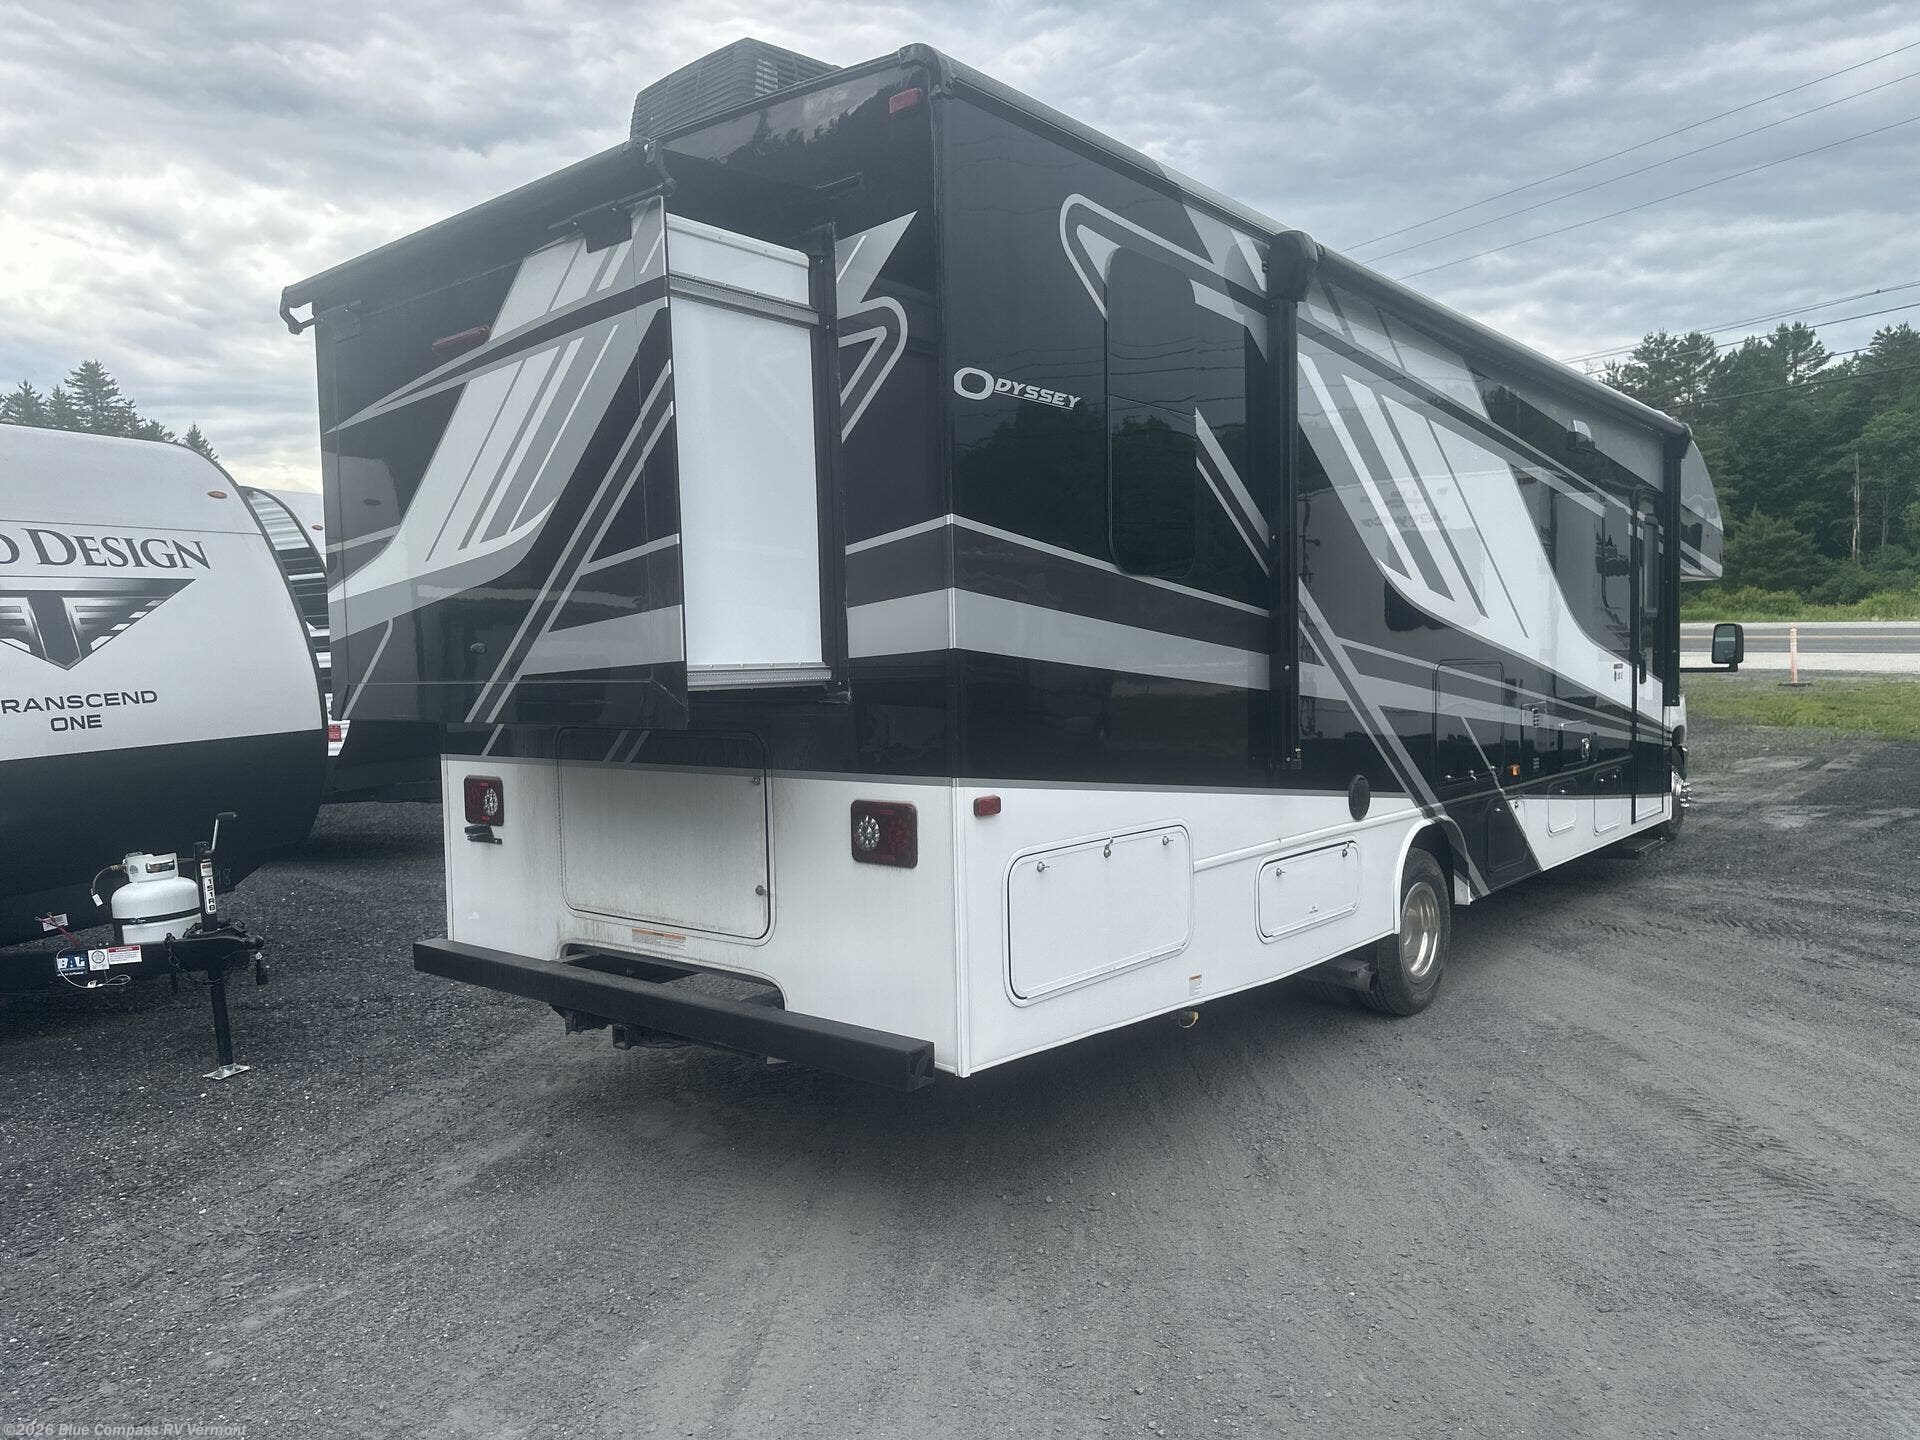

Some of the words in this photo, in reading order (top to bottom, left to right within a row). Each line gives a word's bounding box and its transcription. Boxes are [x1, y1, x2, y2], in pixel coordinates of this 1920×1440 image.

[953, 366, 1081, 410] ODYSSEY
[21, 528, 211, 570] DESIGN
[0, 690, 158, 714] RANSCEND
[50, 714, 103, 732] ONE
